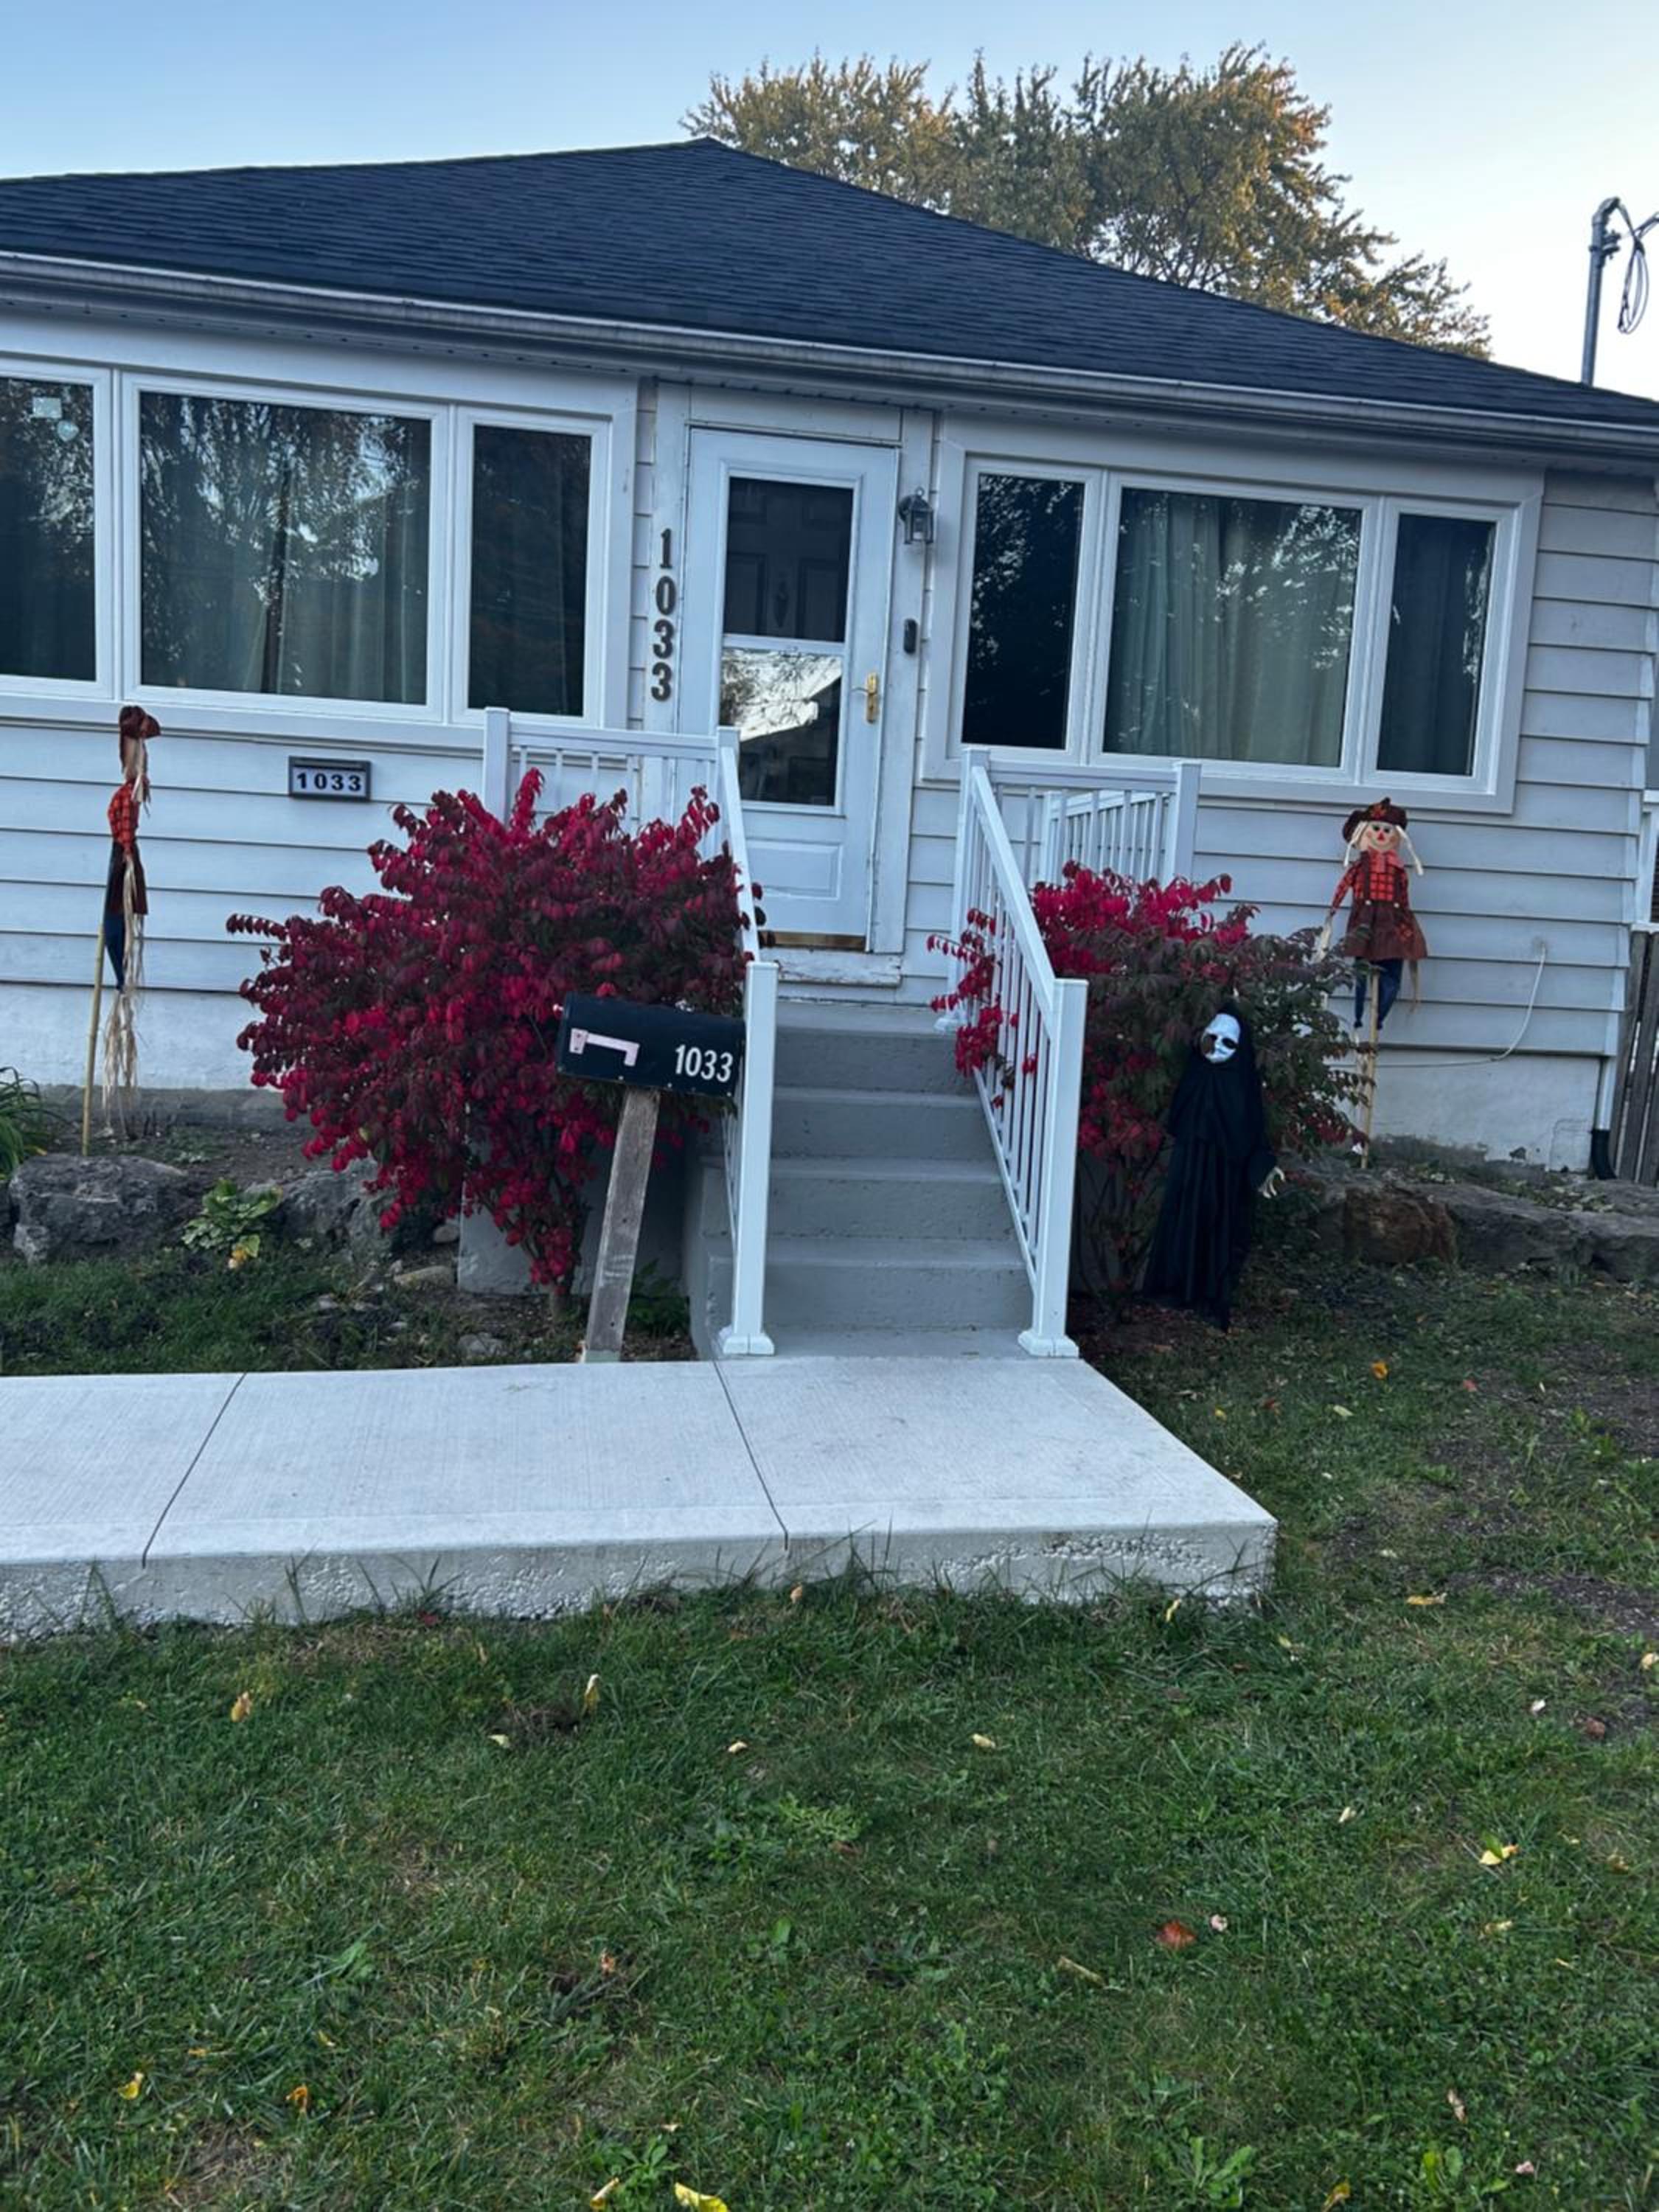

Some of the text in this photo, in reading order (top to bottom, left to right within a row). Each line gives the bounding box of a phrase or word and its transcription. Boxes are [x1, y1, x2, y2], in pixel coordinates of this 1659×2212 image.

[651, 528, 676, 702] 1033
[297, 772, 361, 792] 1033
[675, 1044, 734, 1083] 1033
